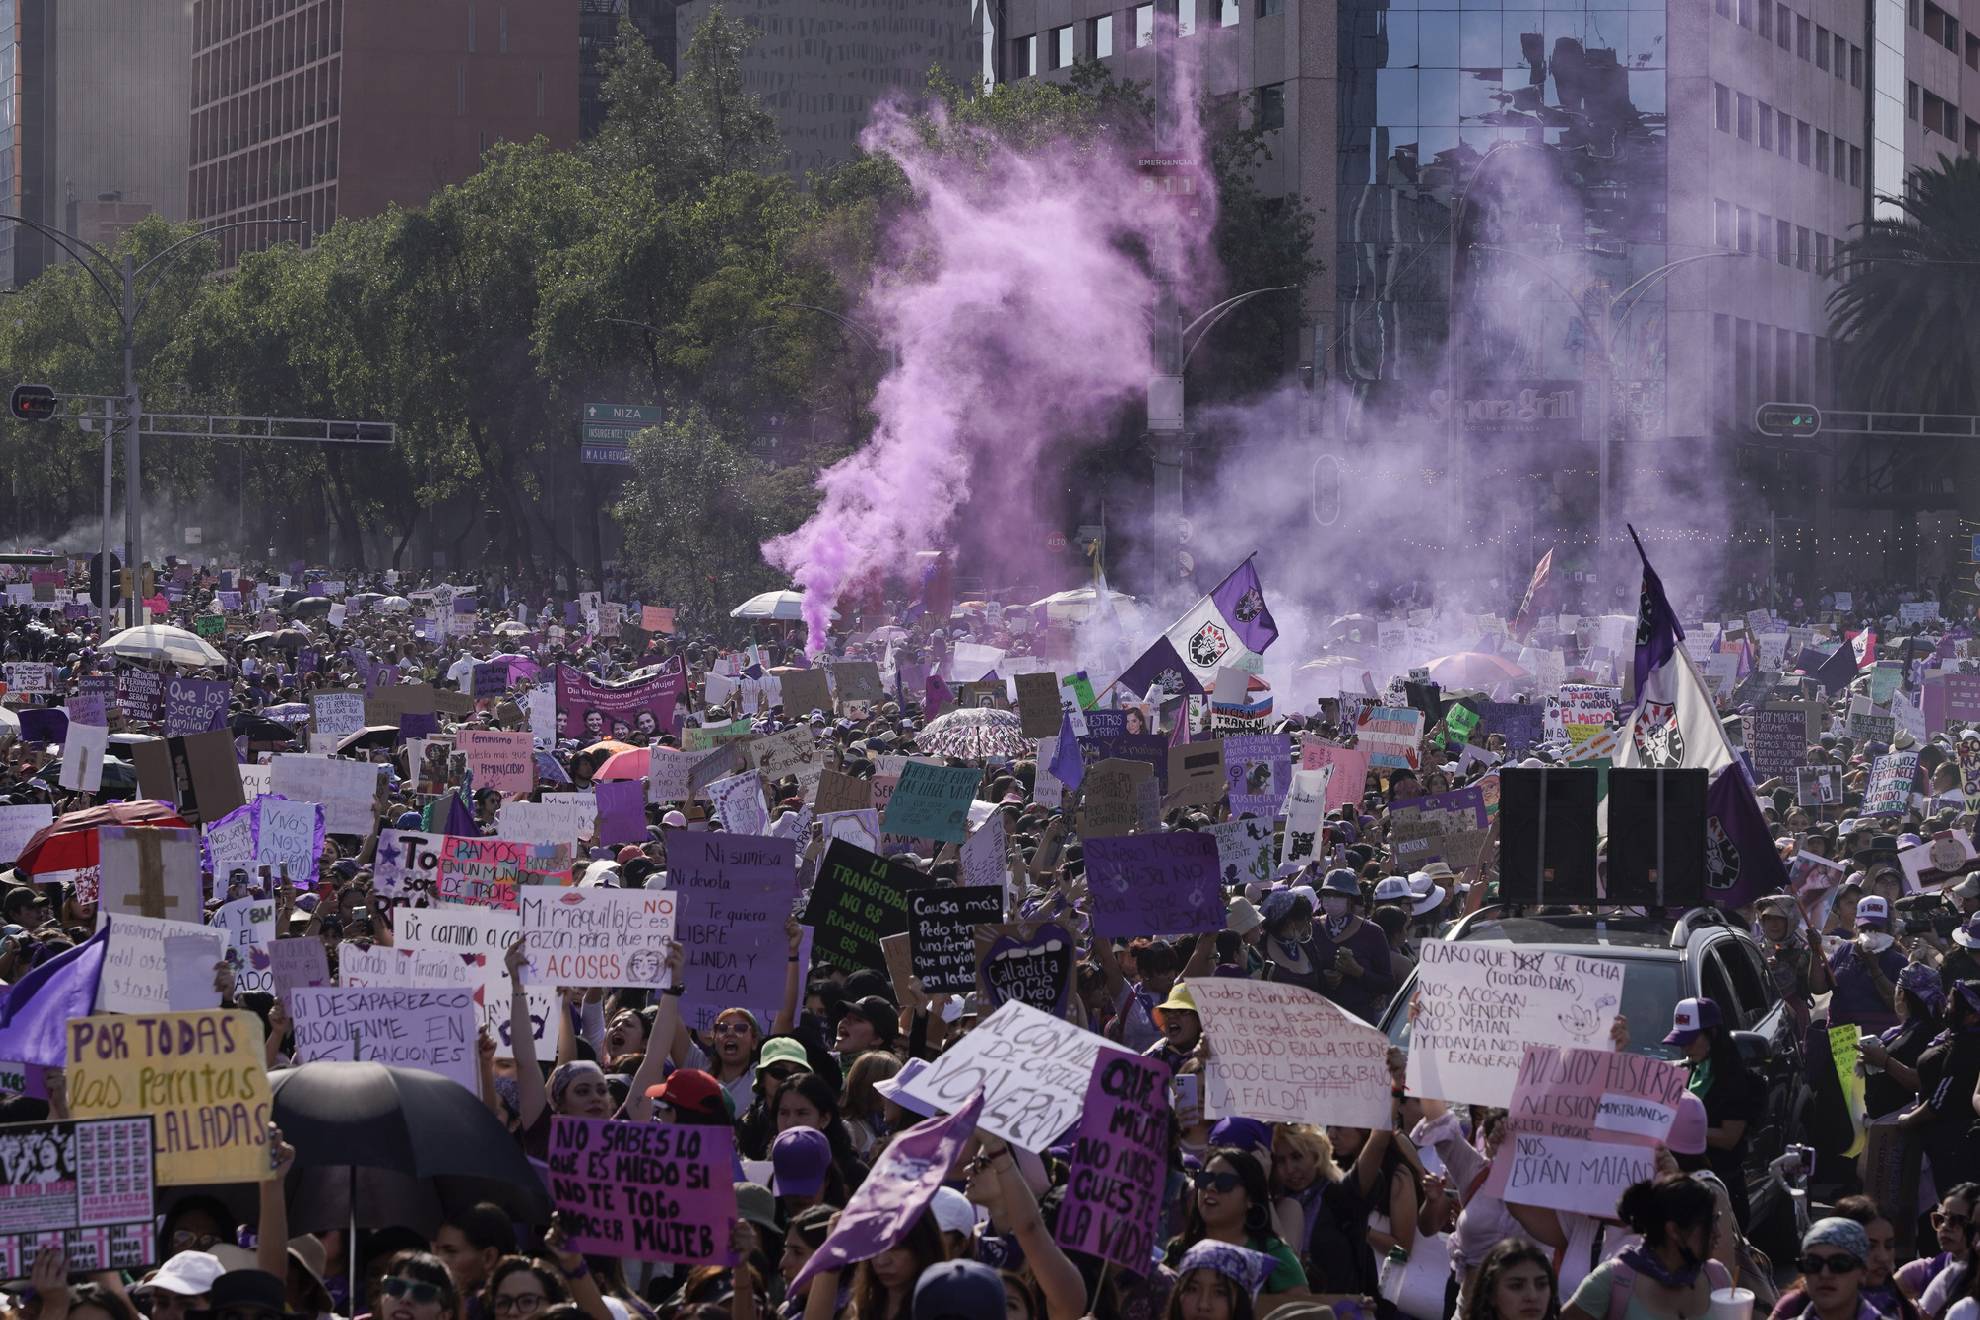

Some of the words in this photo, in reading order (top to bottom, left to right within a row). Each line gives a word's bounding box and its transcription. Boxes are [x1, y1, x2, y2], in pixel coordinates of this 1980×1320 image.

[1138, 159, 1198, 167] EMERGENCIAS
[613, 408, 641, 418] NIZA
[599, 450, 608, 460] LA
[170, 681, 197, 703] Que
[203, 686, 225, 705] los
[581, 687, 633, 699] Internacional
[651, 680, 676, 692] Mujer
[1570, 692, 1593, 701] TANTO
[1593, 691, 1611, 700] QUE
[1216, 705, 1229, 716] NI
[1561, 700, 1577, 709] NOS
[1580, 698, 1619, 713] QUITARON
[1086, 712, 1123, 727] UESTROS
[1561, 708, 1576, 725] EL
[1577, 711, 1615, 726] MIEDO
[1755, 711, 1774, 723] HOY
[471, 734, 512, 746] feminismo
[511, 751, 528, 762] que
[1898, 756, 1916, 769] VOZ
[1870, 766, 1914, 782] PERTENECE
[1891, 780, 1913, 793] TODO
[1877, 800, 1908, 813] QUIERA
[445, 837, 519, 865] ERAMOS
[704, 842, 726, 863] Ni
[727, 850, 783, 867] sumisa
[462, 862, 481, 877] UN
[482, 863, 541, 886] MUNDO
[669, 868, 686, 886] Ni
[689, 868, 731, 891] devota
[869, 859, 889, 880] LA
[442, 877, 464, 894] DE
[522, 897, 548, 928] Mi
[643, 899, 674, 915] NO
[839, 891, 860, 914] NO
[913, 896, 960, 917] Causa
[964, 894, 1000, 912] más
[240, 907, 248, 926] Y
[249, 904, 274, 925] 8M
[552, 900, 642, 932] maquillaje
[649, 918, 670, 930] es
[703, 901, 723, 920] Te
[726, 908, 768, 930] quiero
[239, 929, 260, 946] EL
[431, 921, 478, 947] camino
[486, 930, 497, 946] a
[674, 924, 730, 946] LIBRE
[919, 920, 951, 939] Pedo
[577, 930, 610, 954] para
[617, 932, 641, 956] que
[646, 933, 673, 947] me
[919, 941, 941, 955] una
[393, 953, 406, 976] la
[453, 965, 466, 981] es
[689, 949, 738, 970] LINDA
[745, 952, 759, 970] Y
[913, 956, 936, 970] que
[938, 954, 954, 966] un
[1421, 942, 1472, 966] CLARO
[1472, 946, 1509, 969] QUE
[1575, 958, 1620, 982] LUCHA
[923, 974, 942, 989] en
[944, 970, 960, 985] la
[987, 955, 1059, 987] Calladita
[1025, 974, 1054, 990] me
[704, 971, 749, 995] LOCA
[995, 980, 1026, 1005] NO
[1026, 980, 1057, 1001] veo
[1189, 983, 1245, 1001] Todo
[1418, 980, 1453, 999] NOS
[294, 992, 308, 1019] SI
[315, 990, 472, 1018] DESAPAREZCO
[1417, 1000, 1456, 1019] NOS
[1458, 1002, 1521, 1020] VENDEN
[293, 1018, 409, 1049] BUSQUENME
[423, 1013, 466, 1044] EN
[1412, 1017, 1454, 1034] NOS
[1457, 1017, 1511, 1037] MATAN
[73, 1022, 129, 1063] POR
[136, 1016, 236, 1057] TODAS
[1014, 1021, 1073, 1063] CON
[1490, 1037, 1522, 1052] NOS
[358, 1043, 466, 1067] CANCIONES
[979, 1039, 1018, 1066] DE
[1207, 1062, 1259, 1082] TODO
[1260, 1063, 1287, 1082] EL
[1287, 1062, 1357, 1082] PODER
[1356, 1064, 1393, 1089] BAJO
[1521, 1048, 1553, 1087] NI
[1553, 1048, 1601, 1087] ESTOY
[69, 1069, 122, 1110] las
[139, 1064, 258, 1109] Perritas
[1209, 1087, 1237, 1110] LA
[1242, 1086, 1308, 1111] FALDA
[1519, 1094, 1550, 1118] NI
[1550, 1093, 1602, 1121] ESTOY
[1599, 1101, 1672, 1125] MENSTRUANDO
[556, 1120, 590, 1152] NO
[601, 1124, 671, 1158] SABES
[675, 1129, 701, 1160] LO
[1550, 1122, 1595, 1141] PORQUE
[1077, 1138, 1110, 1168] NO
[1516, 1137, 1547, 1156] NOS
[549, 1152, 579, 1176] QUE
[587, 1152, 610, 1180] ES
[615, 1155, 681, 1186] MIEDO
[685, 1162, 711, 1191] SI
[1511, 1153, 1571, 1188] ESTÁN
[553, 1177, 587, 1205] NO
[586, 1182, 616, 1213] TE
[1074, 1170, 1157, 1224] CUESTE
[112, 1239, 142, 1252] UNA
[631, 1218, 715, 1260] MUJER
[1061, 1198, 1093, 1249] LA
[1101, 1216, 1157, 1277] VIDA
[67, 1243, 98, 1257] UNA
